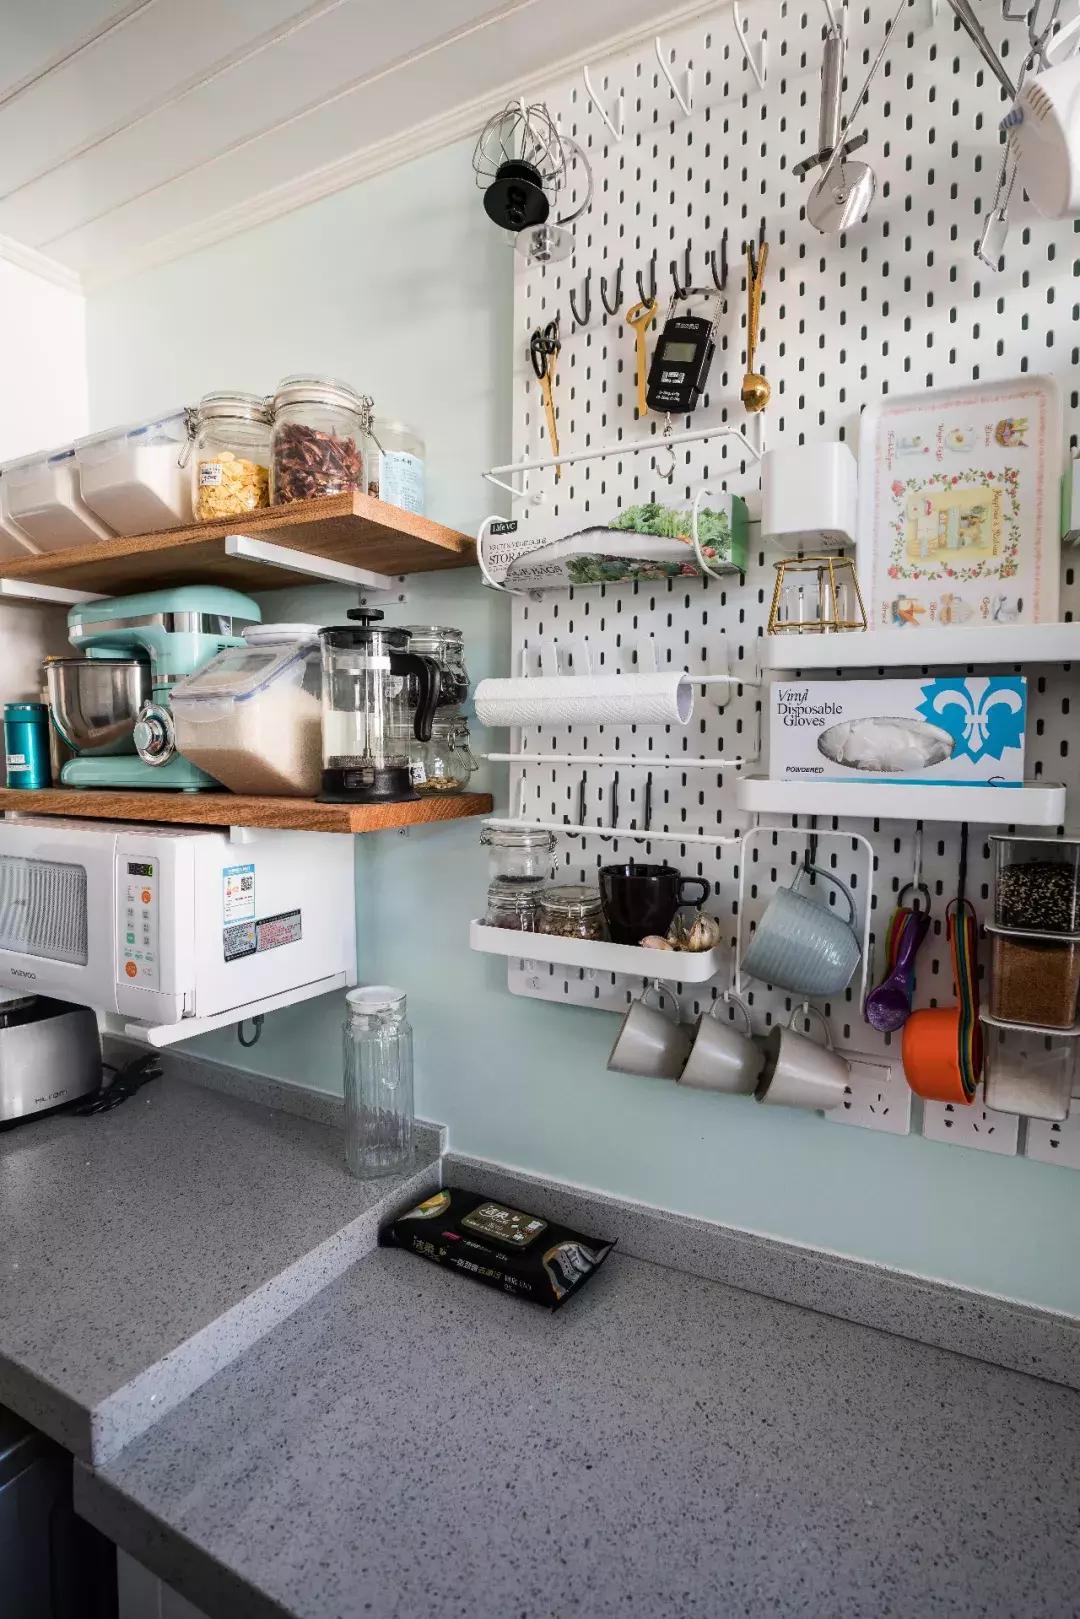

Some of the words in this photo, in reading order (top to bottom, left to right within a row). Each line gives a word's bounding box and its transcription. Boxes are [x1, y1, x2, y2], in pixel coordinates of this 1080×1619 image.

[779, 689, 809, 705] Vinyl
[777, 702, 843, 717] Disposable
[783, 713, 825, 726] Gloves
[786, 766, 825, 774] POWDERED
